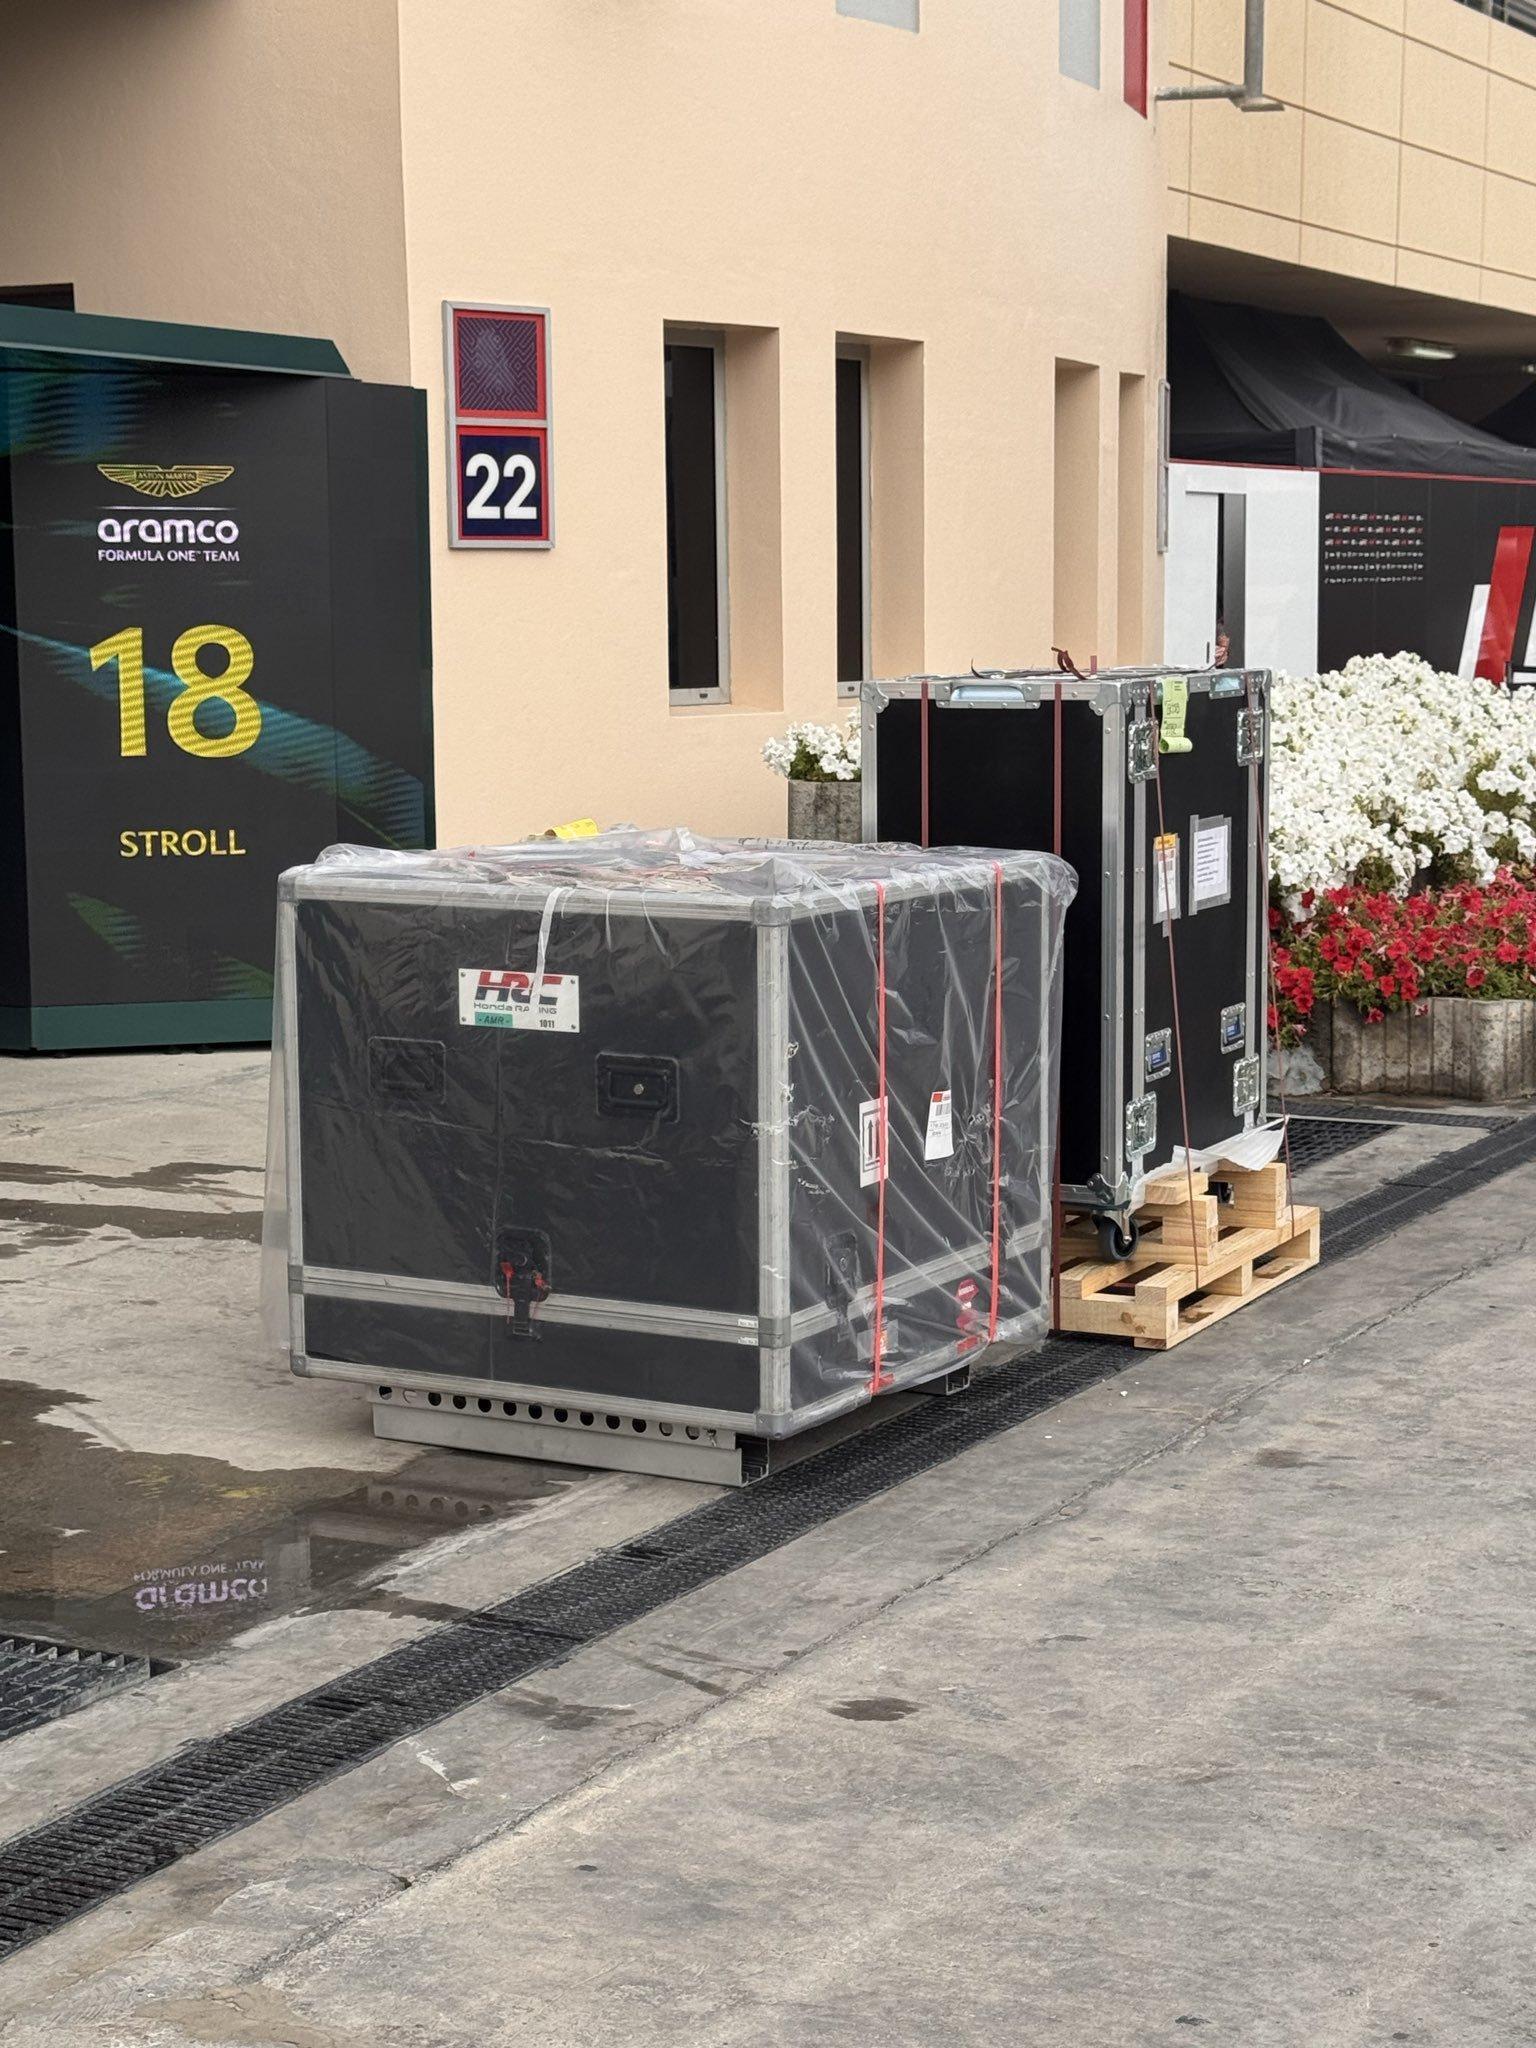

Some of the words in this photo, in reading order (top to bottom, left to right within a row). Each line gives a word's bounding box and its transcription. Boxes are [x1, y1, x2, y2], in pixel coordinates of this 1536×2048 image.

[137, 471, 164, 480] ASTON
[165, 471, 196, 480] MARTIN
[465, 453, 538, 520] 22
[97, 518, 239, 544] aramco
[98, 549, 164, 562] FORMULA
[203, 550, 240, 562] TEAM
[89, 624, 262, 758] 18
[119, 829, 246, 857] STROLL
[473, 1002, 513, 1012] Honda
[515, 1005, 557, 1014] RAING
